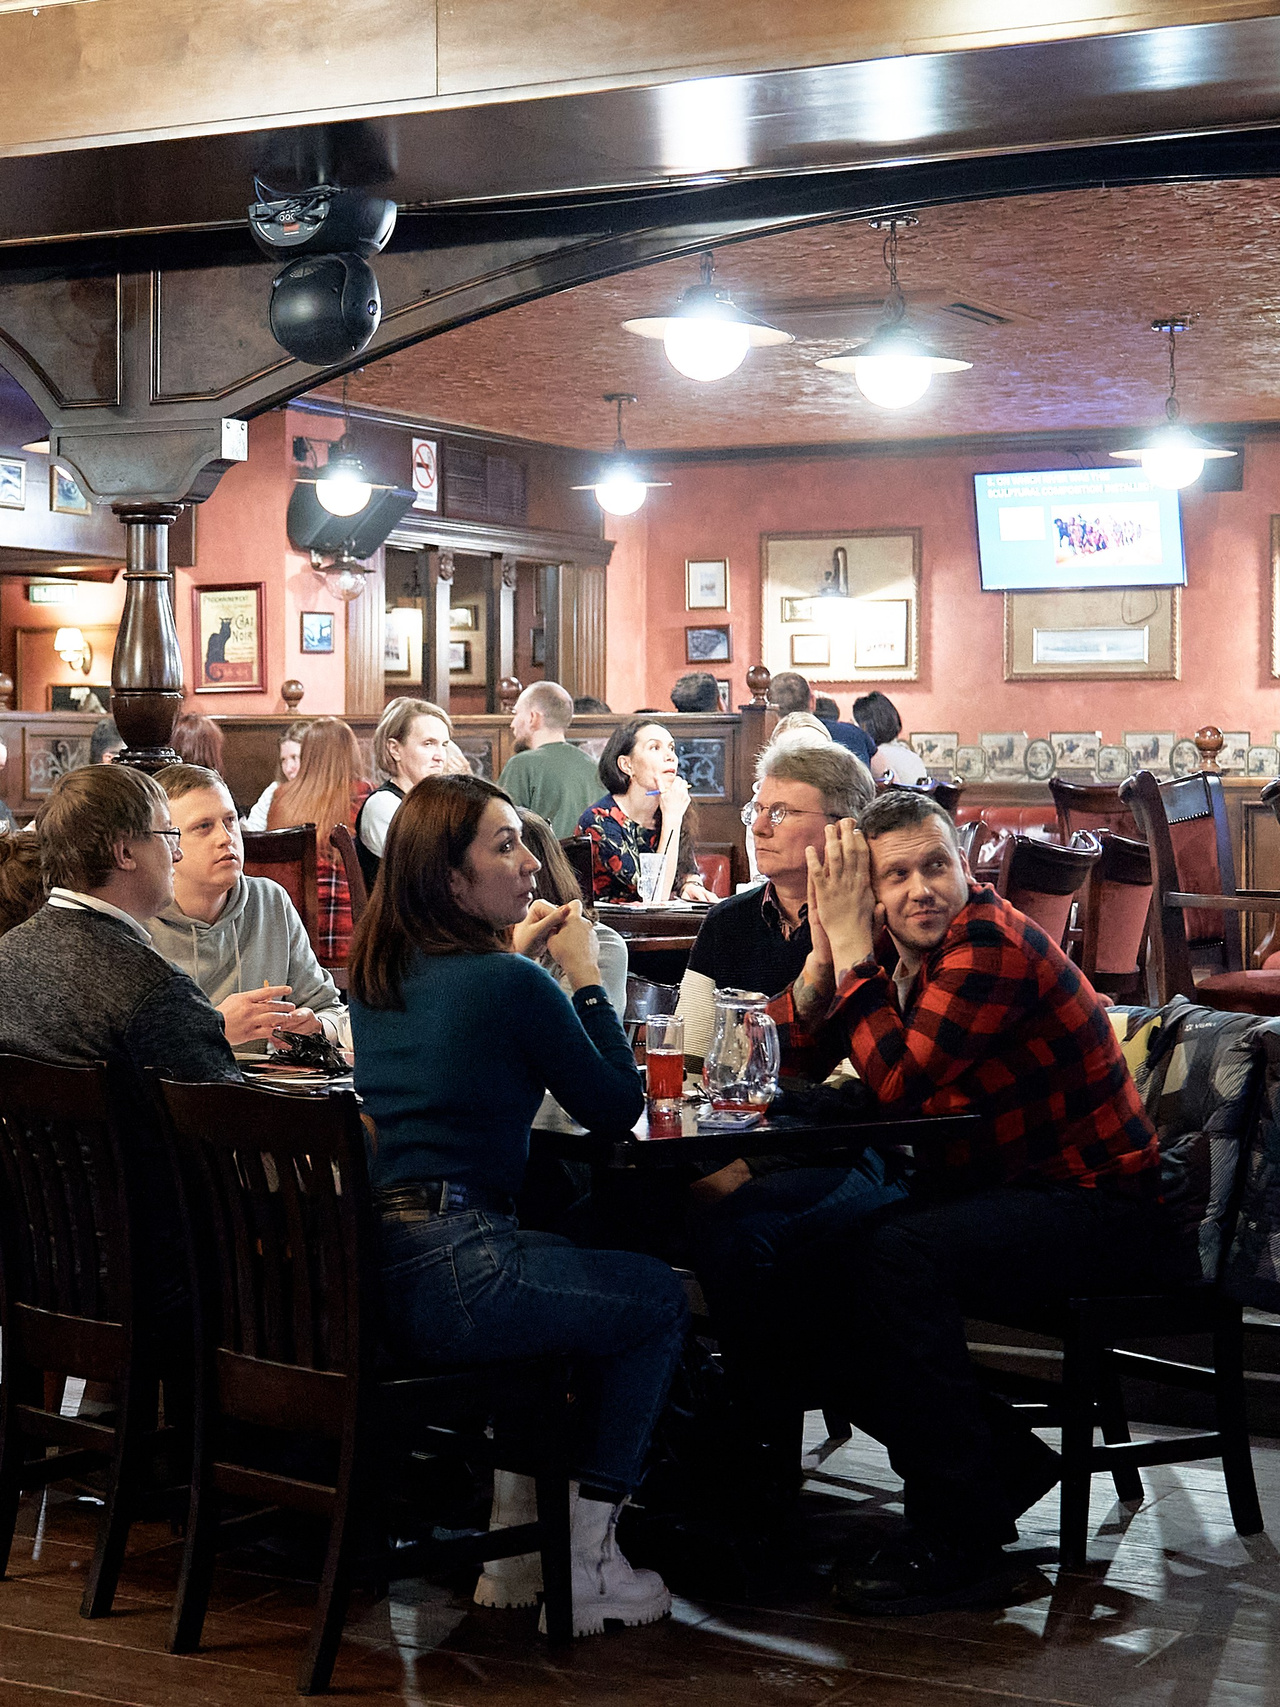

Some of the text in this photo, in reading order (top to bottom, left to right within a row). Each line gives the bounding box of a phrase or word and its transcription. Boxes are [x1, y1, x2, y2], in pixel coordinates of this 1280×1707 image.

[996, 476, 1010, 486] ON
[1011, 474, 1041, 485] WHICH
[1090, 471, 1111, 481] THIS
[987, 487, 1041, 499] SCULPTURAL
[1041, 483, 1103, 497] COMPOSITION
[232, 631, 253, 643] NOIR
